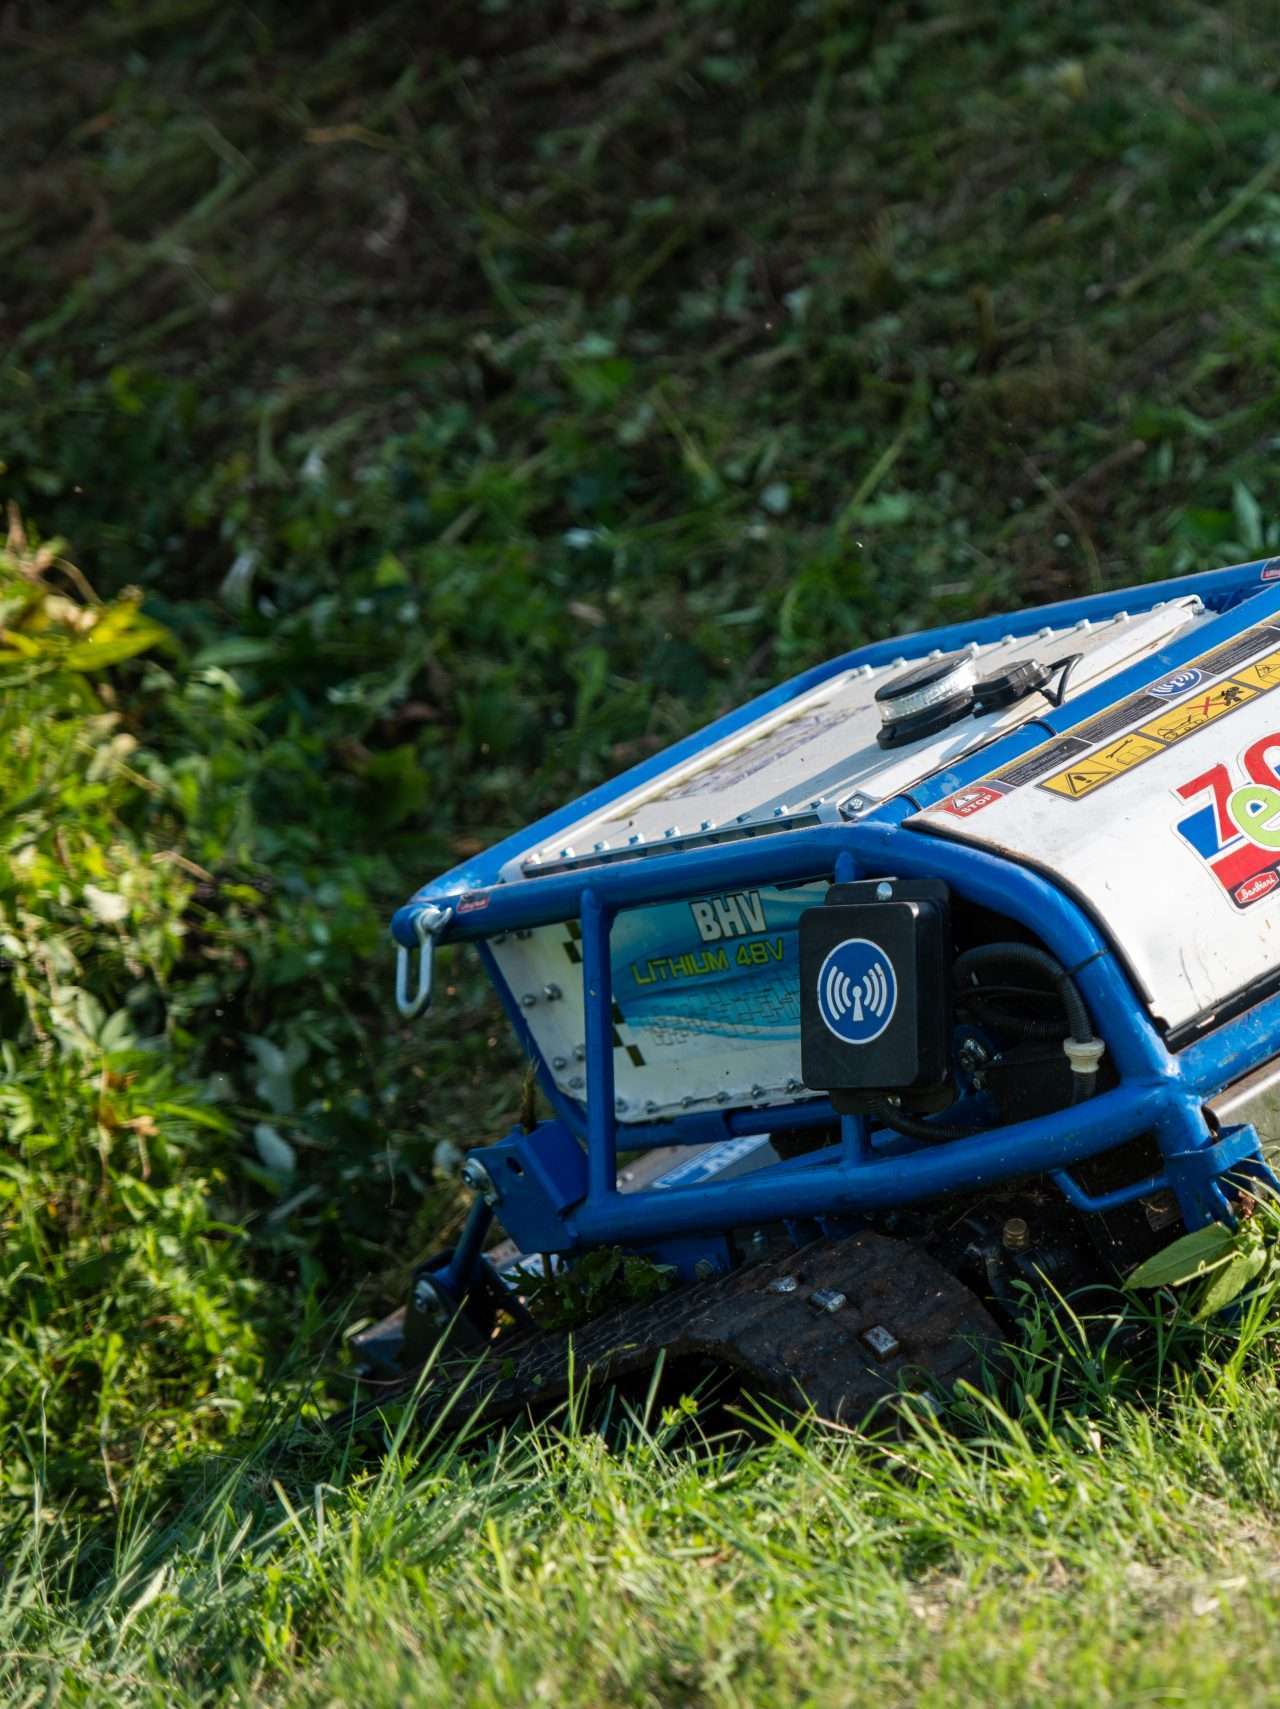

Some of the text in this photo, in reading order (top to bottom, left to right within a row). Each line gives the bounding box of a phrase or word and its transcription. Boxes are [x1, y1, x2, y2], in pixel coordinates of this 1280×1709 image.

[960, 792, 992, 813] STOP
[690, 890, 767, 943] BHV
[630, 936, 784, 985] LITHIUM 48V
